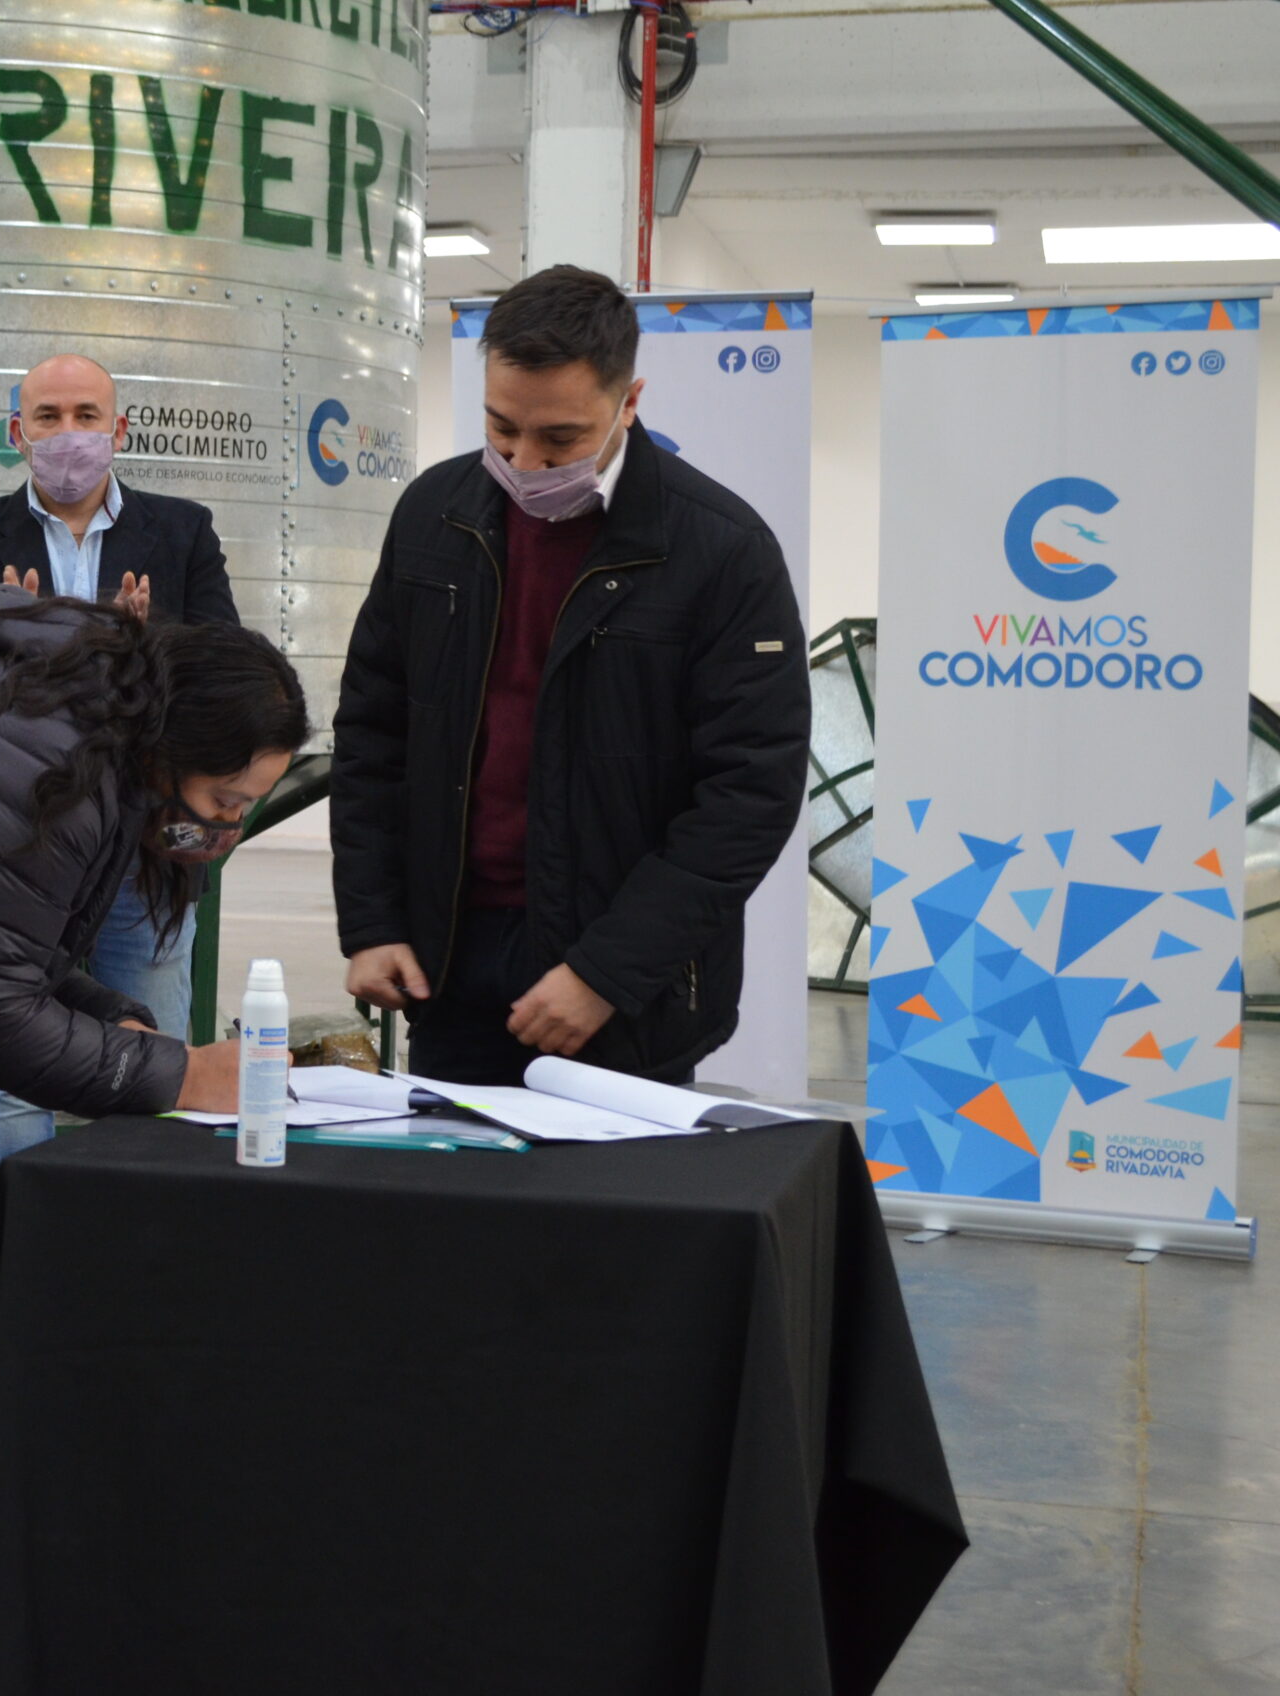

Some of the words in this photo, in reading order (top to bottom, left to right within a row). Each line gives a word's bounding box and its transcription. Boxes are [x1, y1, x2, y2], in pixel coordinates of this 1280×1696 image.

[125, 404, 253, 433] COMODORO
[120, 431, 268, 461] ONOCIMIENTO
[138, 467, 153, 479] DE
[156, 468, 224, 483] DESARROLLO
[972, 614, 1149, 648] VIVAMOS
[919, 650, 1204, 691] COMODORO
[1105, 1134, 1187, 1151] MUNICIPALIDAD
[1189, 1141, 1204, 1151] DE
[1105, 1144, 1205, 1167] COMODORO
[1105, 1159, 1186, 1180] RIVADAVIA
